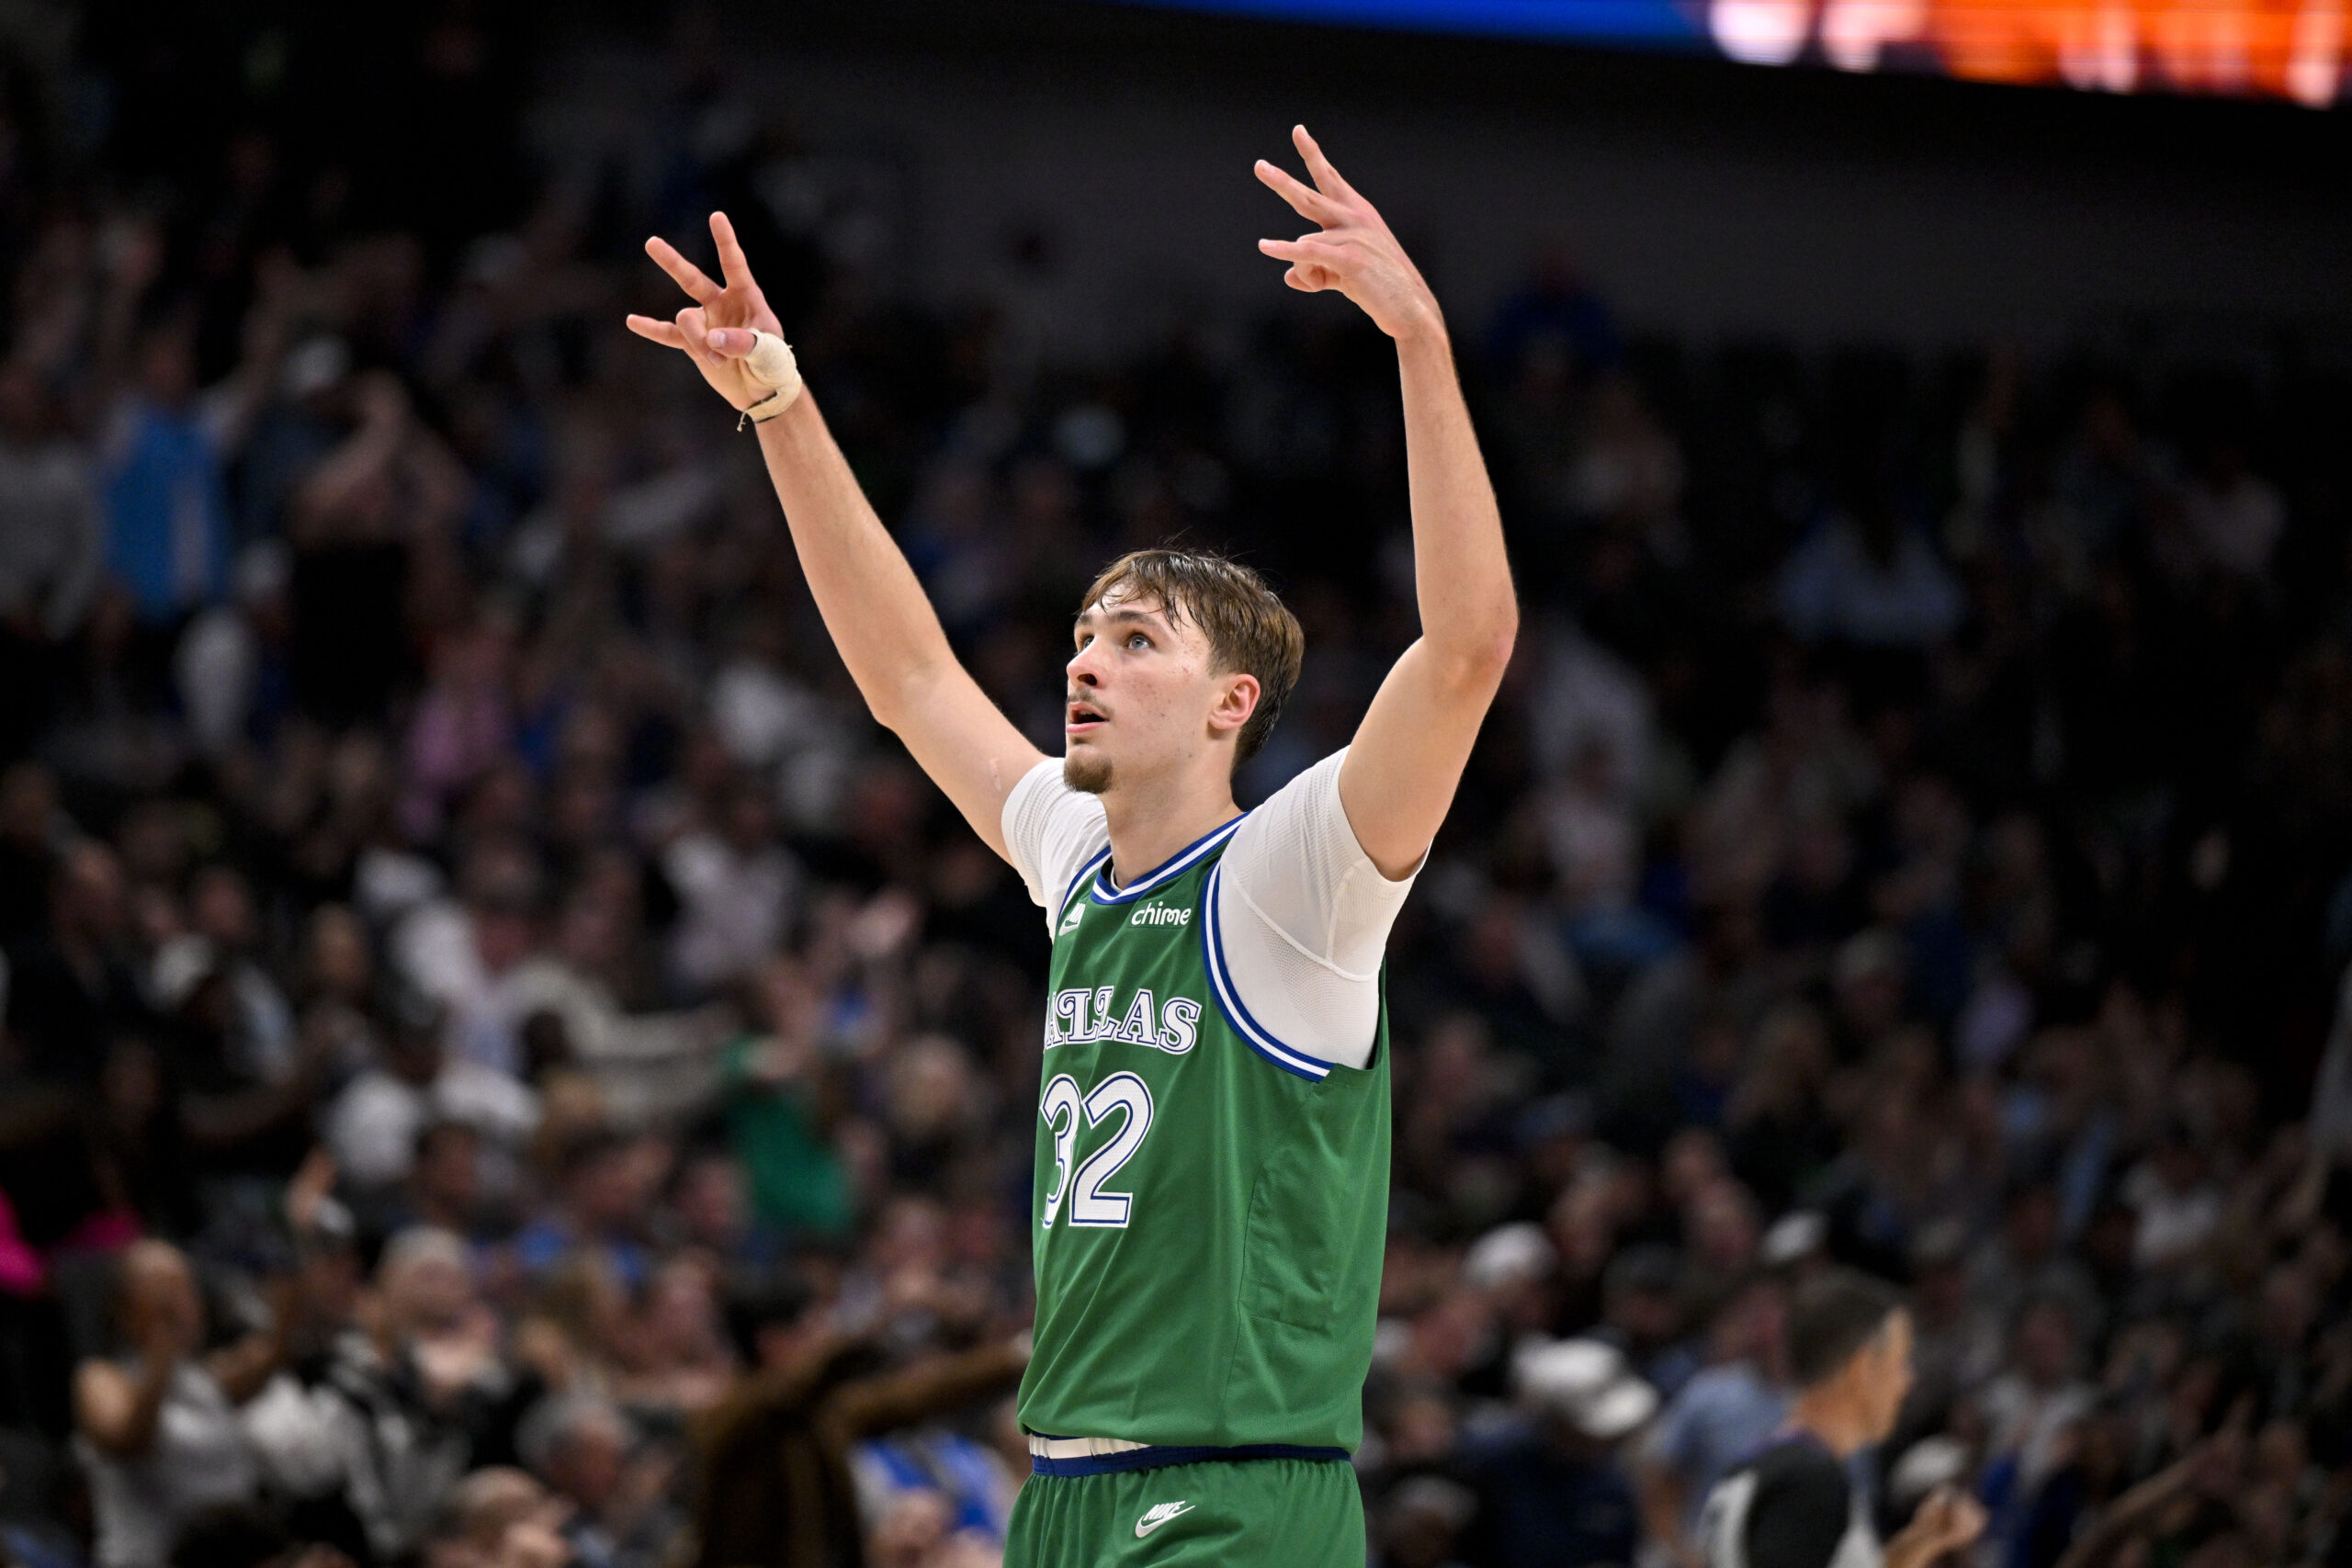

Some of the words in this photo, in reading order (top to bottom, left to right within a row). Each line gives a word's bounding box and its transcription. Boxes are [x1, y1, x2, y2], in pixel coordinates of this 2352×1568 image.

[1131, 900, 1192, 926] chime
[1044, 985, 1202, 1055] ALLAS
[1040, 1070, 1154, 1229] 32
